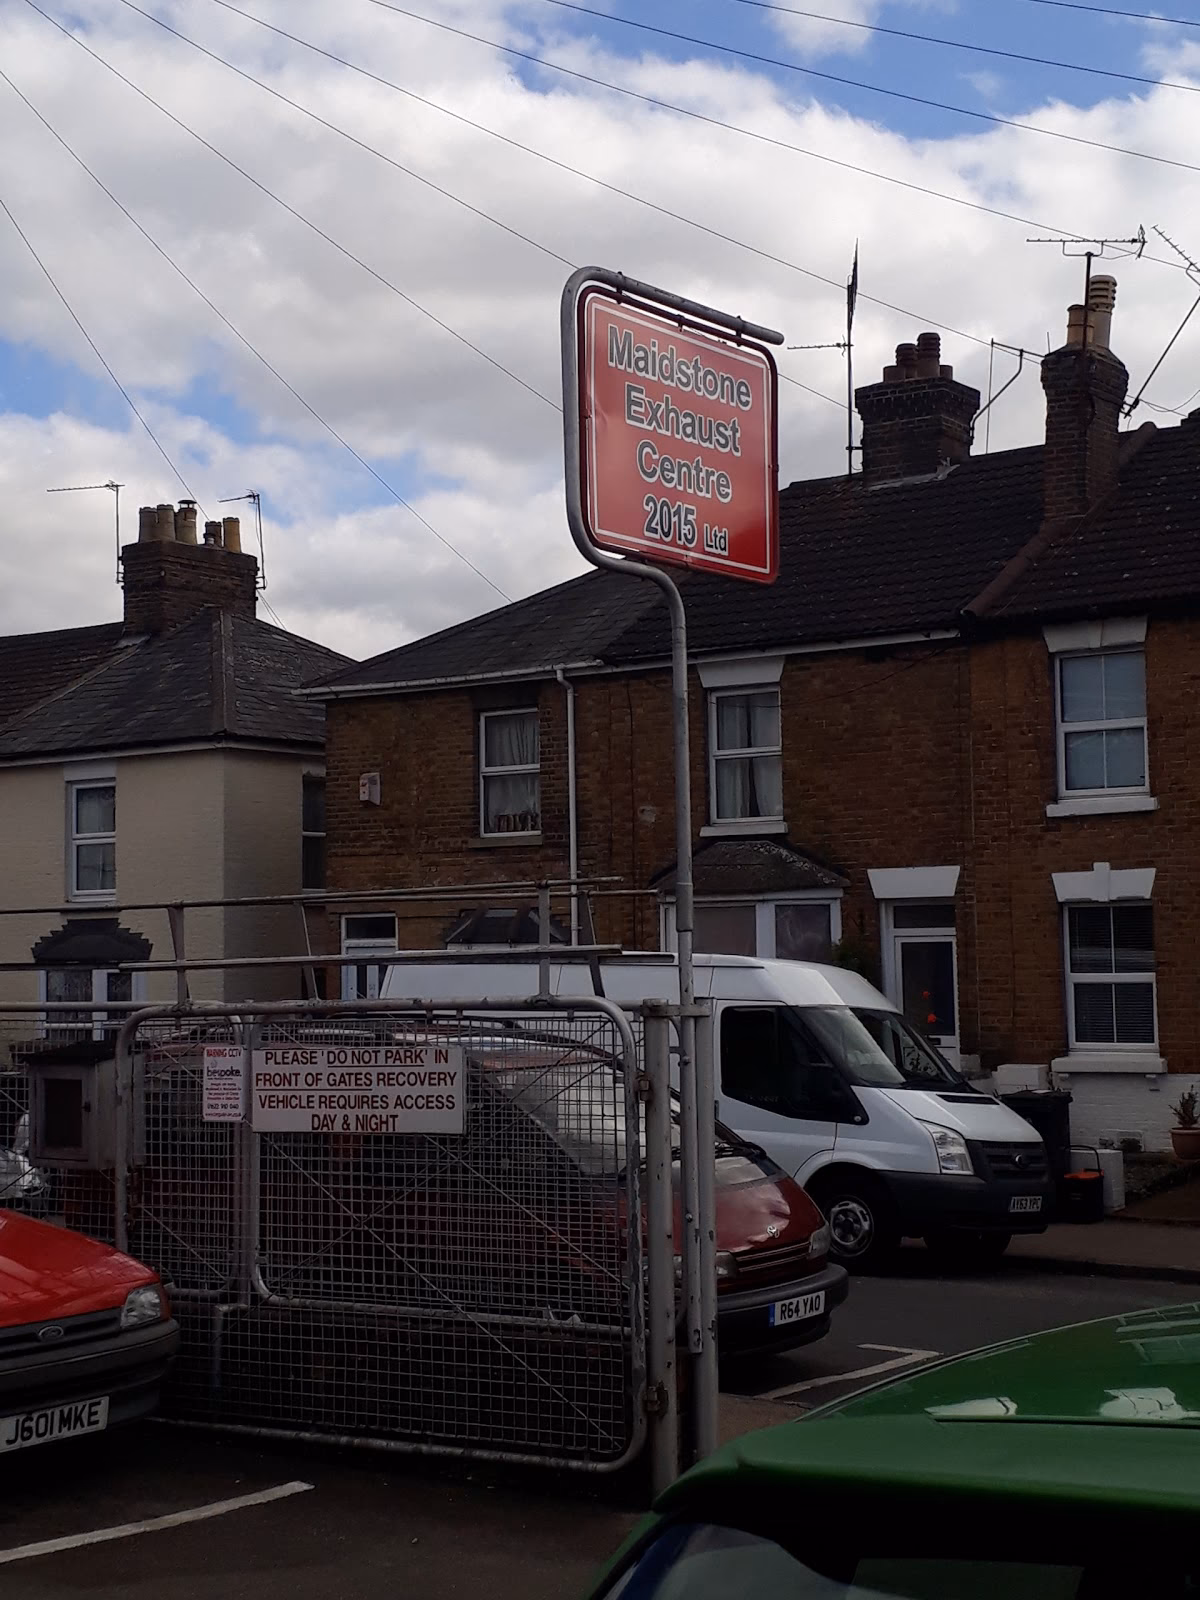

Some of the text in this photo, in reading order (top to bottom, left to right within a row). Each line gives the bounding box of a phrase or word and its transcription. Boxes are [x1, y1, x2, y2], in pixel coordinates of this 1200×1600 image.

[608, 323, 752, 411] Maidstone
[625, 382, 742, 457] Exhaust
[636, 440, 732, 503] Centre
[643, 495, 729, 556] 2015 Ltd
[228, 1048, 241, 1057] CCTV
[265, 1051, 318, 1065] PLEASE
[351, 1050, 381, 1064] NOT
[434, 1049, 449, 1064] IN
[255, 1071, 457, 1087] FRONT OF GATES RECOVERY
[258, 1094, 456, 1110] VEHICLE REQUIRES ACCESS
[311, 1114, 399, 1132] DAY & NIGHT
[780, 1300, 801, 1321] R64
